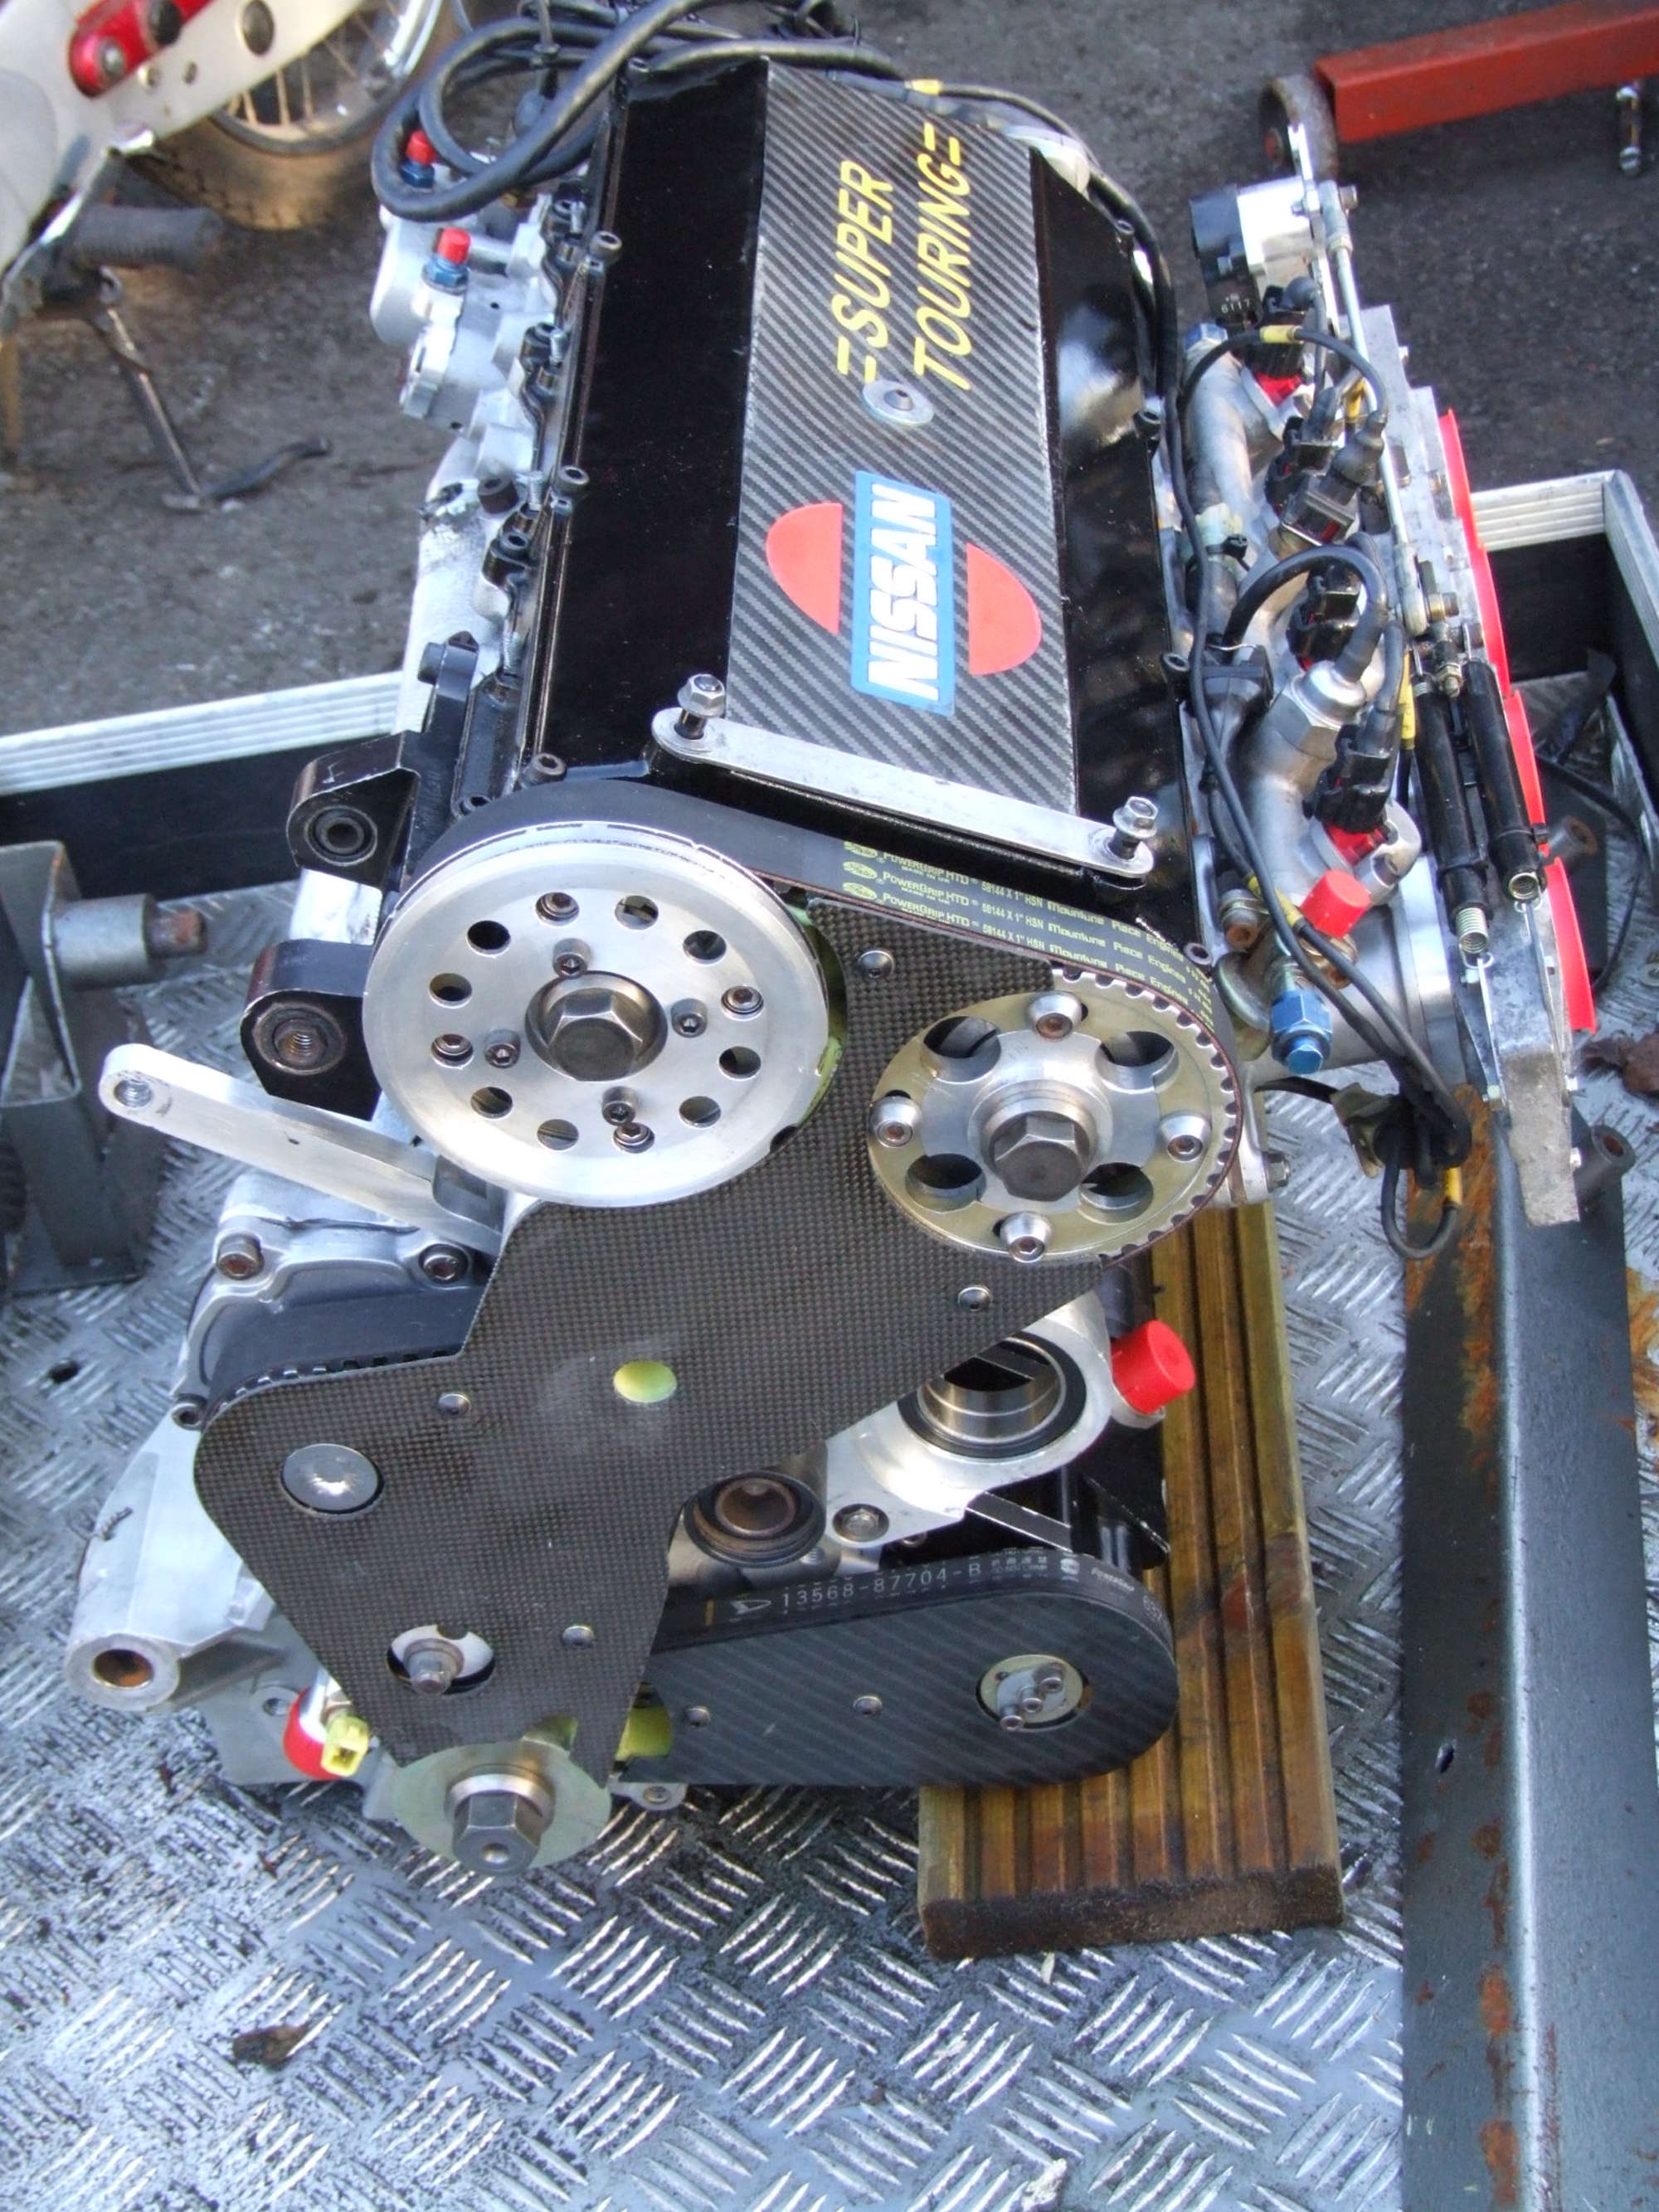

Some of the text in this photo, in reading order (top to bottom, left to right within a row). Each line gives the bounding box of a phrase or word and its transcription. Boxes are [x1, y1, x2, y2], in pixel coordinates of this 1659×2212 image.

[832, 160, 893, 349] SUPER
[914, 153, 971, 391] TOURING
[868, 484, 938, 702] NISSAN
[946, 890, 970, 907] HTD
[1113, 941, 1144, 960] Race
[1147, 954, 1187, 984] Engines
[946, 912, 971, 927] HTD
[1114, 962, 1146, 982] Race
[1149, 975, 1189, 1006] Engines
